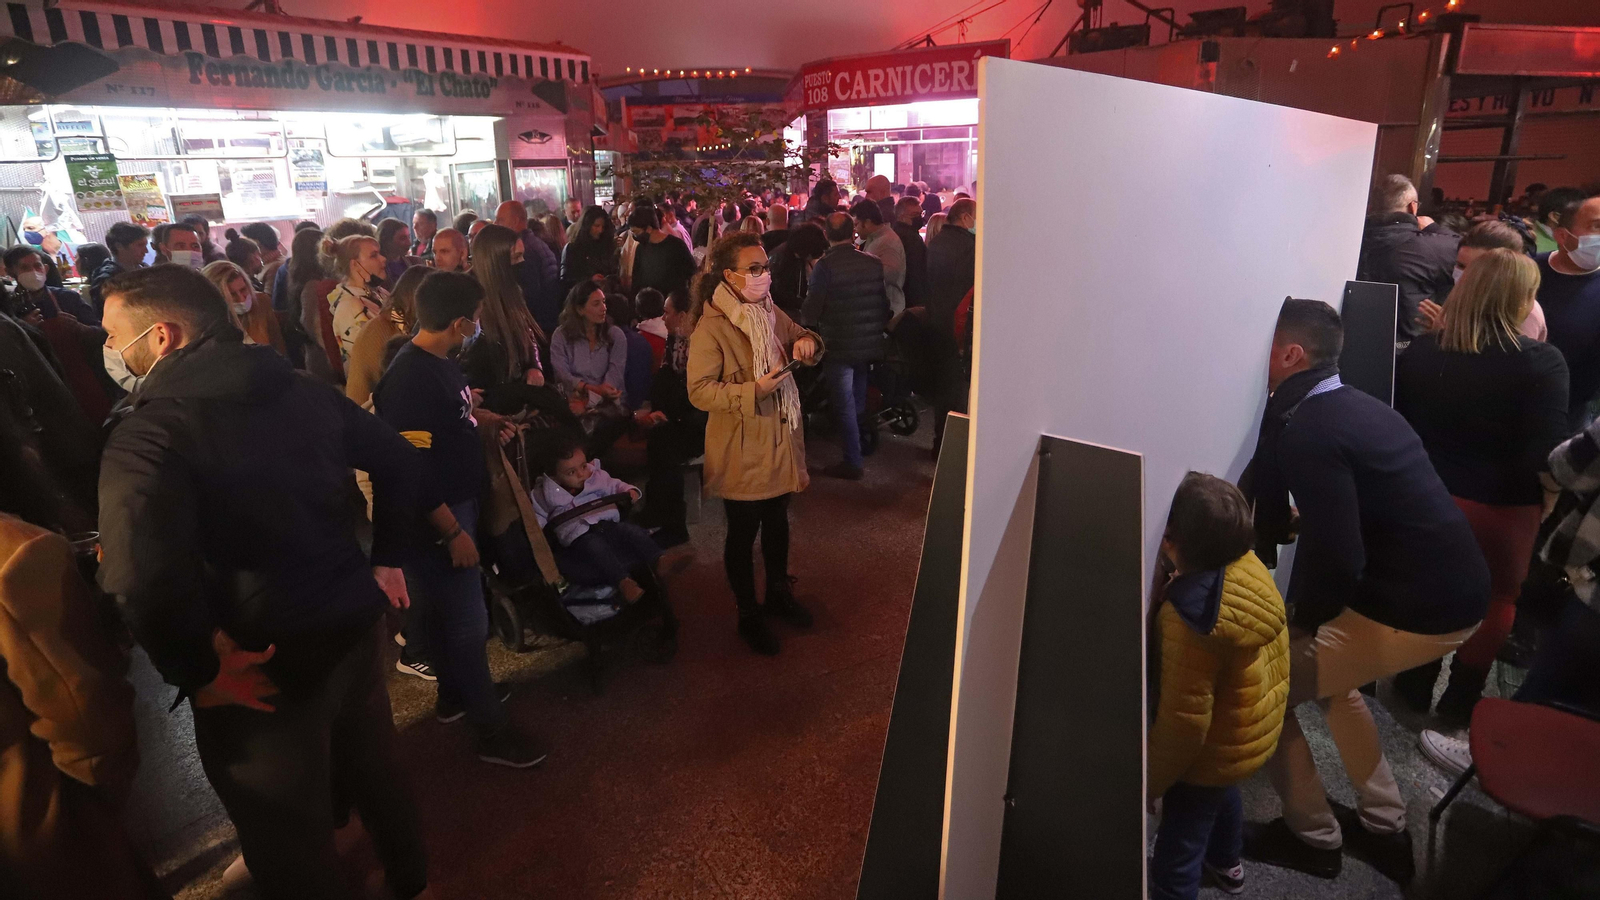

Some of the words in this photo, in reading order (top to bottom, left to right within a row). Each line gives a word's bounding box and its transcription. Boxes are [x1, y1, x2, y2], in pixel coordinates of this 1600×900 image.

[187, 51, 310, 90] Fernando
[315, 64, 386, 94] García
[804, 70, 832, 88] PUESTO
[131, 86, 156, 97] 117
[808, 87, 829, 105] 108
